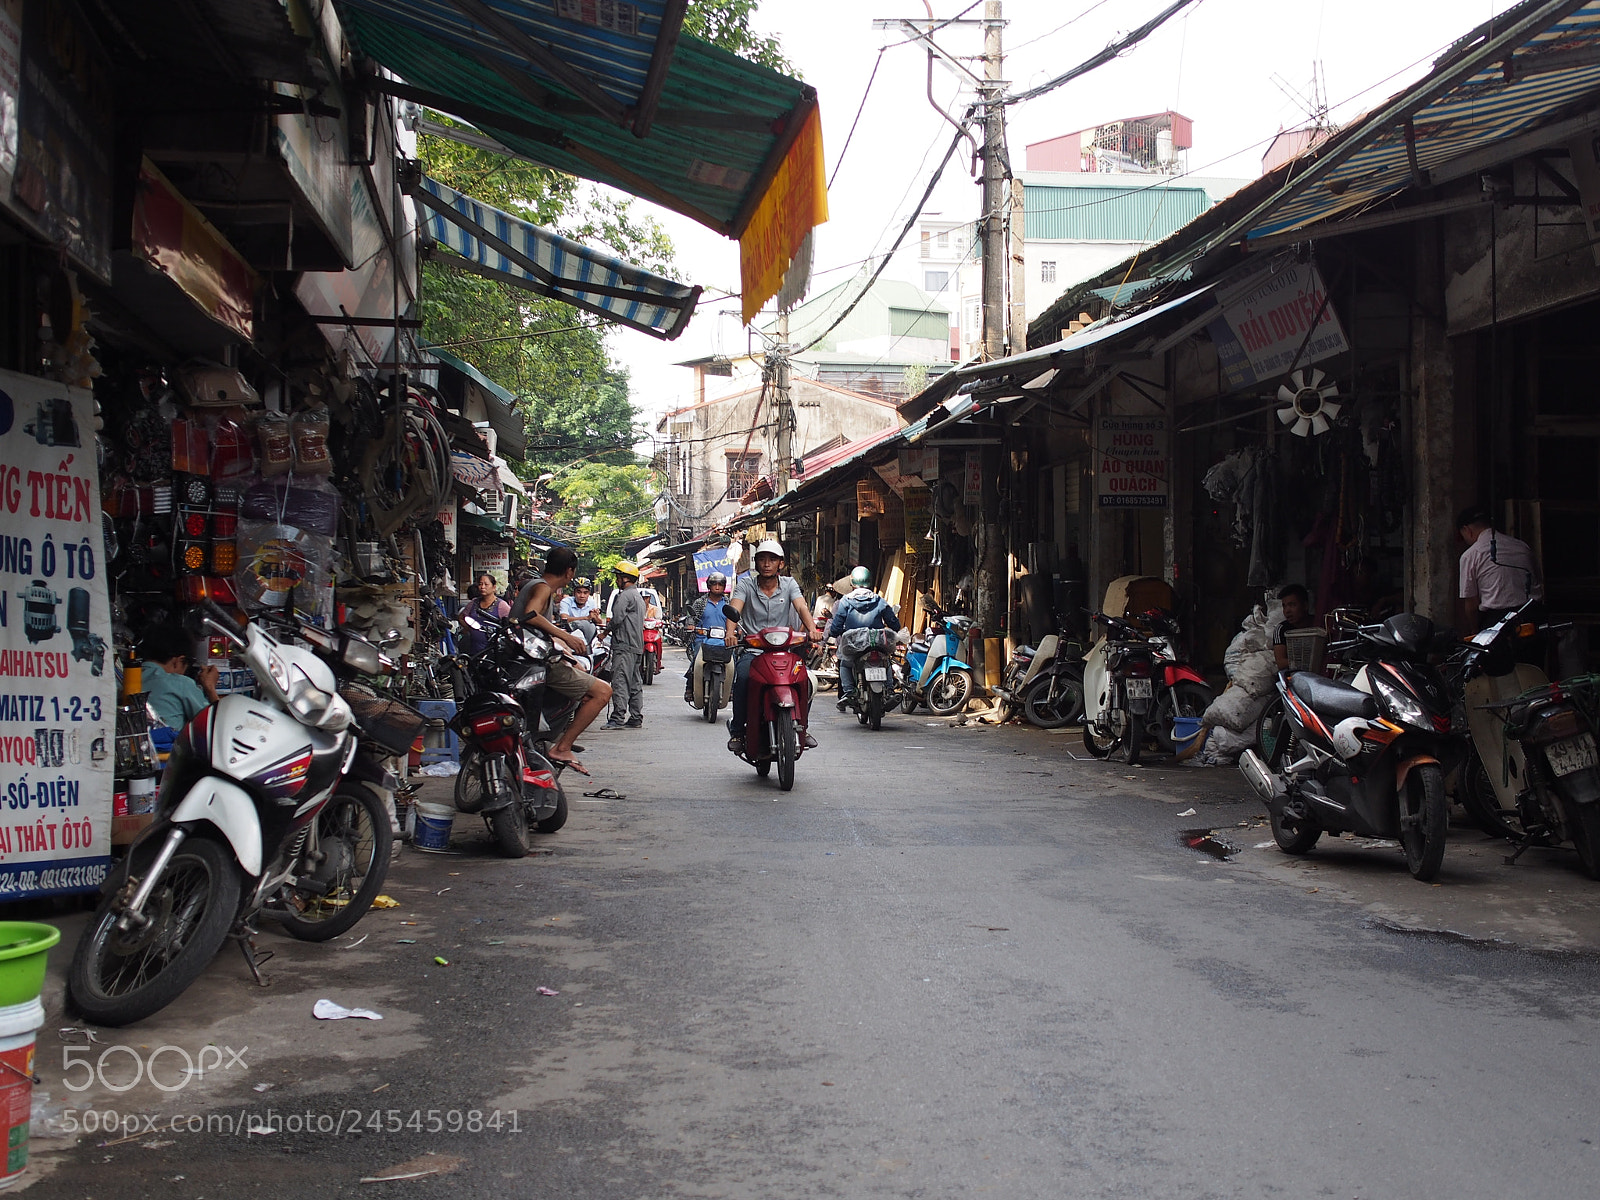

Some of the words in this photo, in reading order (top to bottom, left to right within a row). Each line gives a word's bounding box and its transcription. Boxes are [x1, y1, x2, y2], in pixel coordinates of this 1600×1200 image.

[1238, 308, 1273, 352] HẢI
[1268, 289, 1332, 341] DUYÊN
[1113, 430, 1154, 446] HÙNG
[27, 453, 91, 523] TIẾN
[1109, 475, 1157, 492] QUÁCH
[41, 532, 56, 577] Ô
[63, 537, 95, 581] TÔ
[50, 695, 102, 721] 1-2-3
[0, 772, 80, 813] -SỐ-ĐIỆN
[15, 814, 57, 853] THẤT
[62, 815, 92, 849] ÔTÔ
